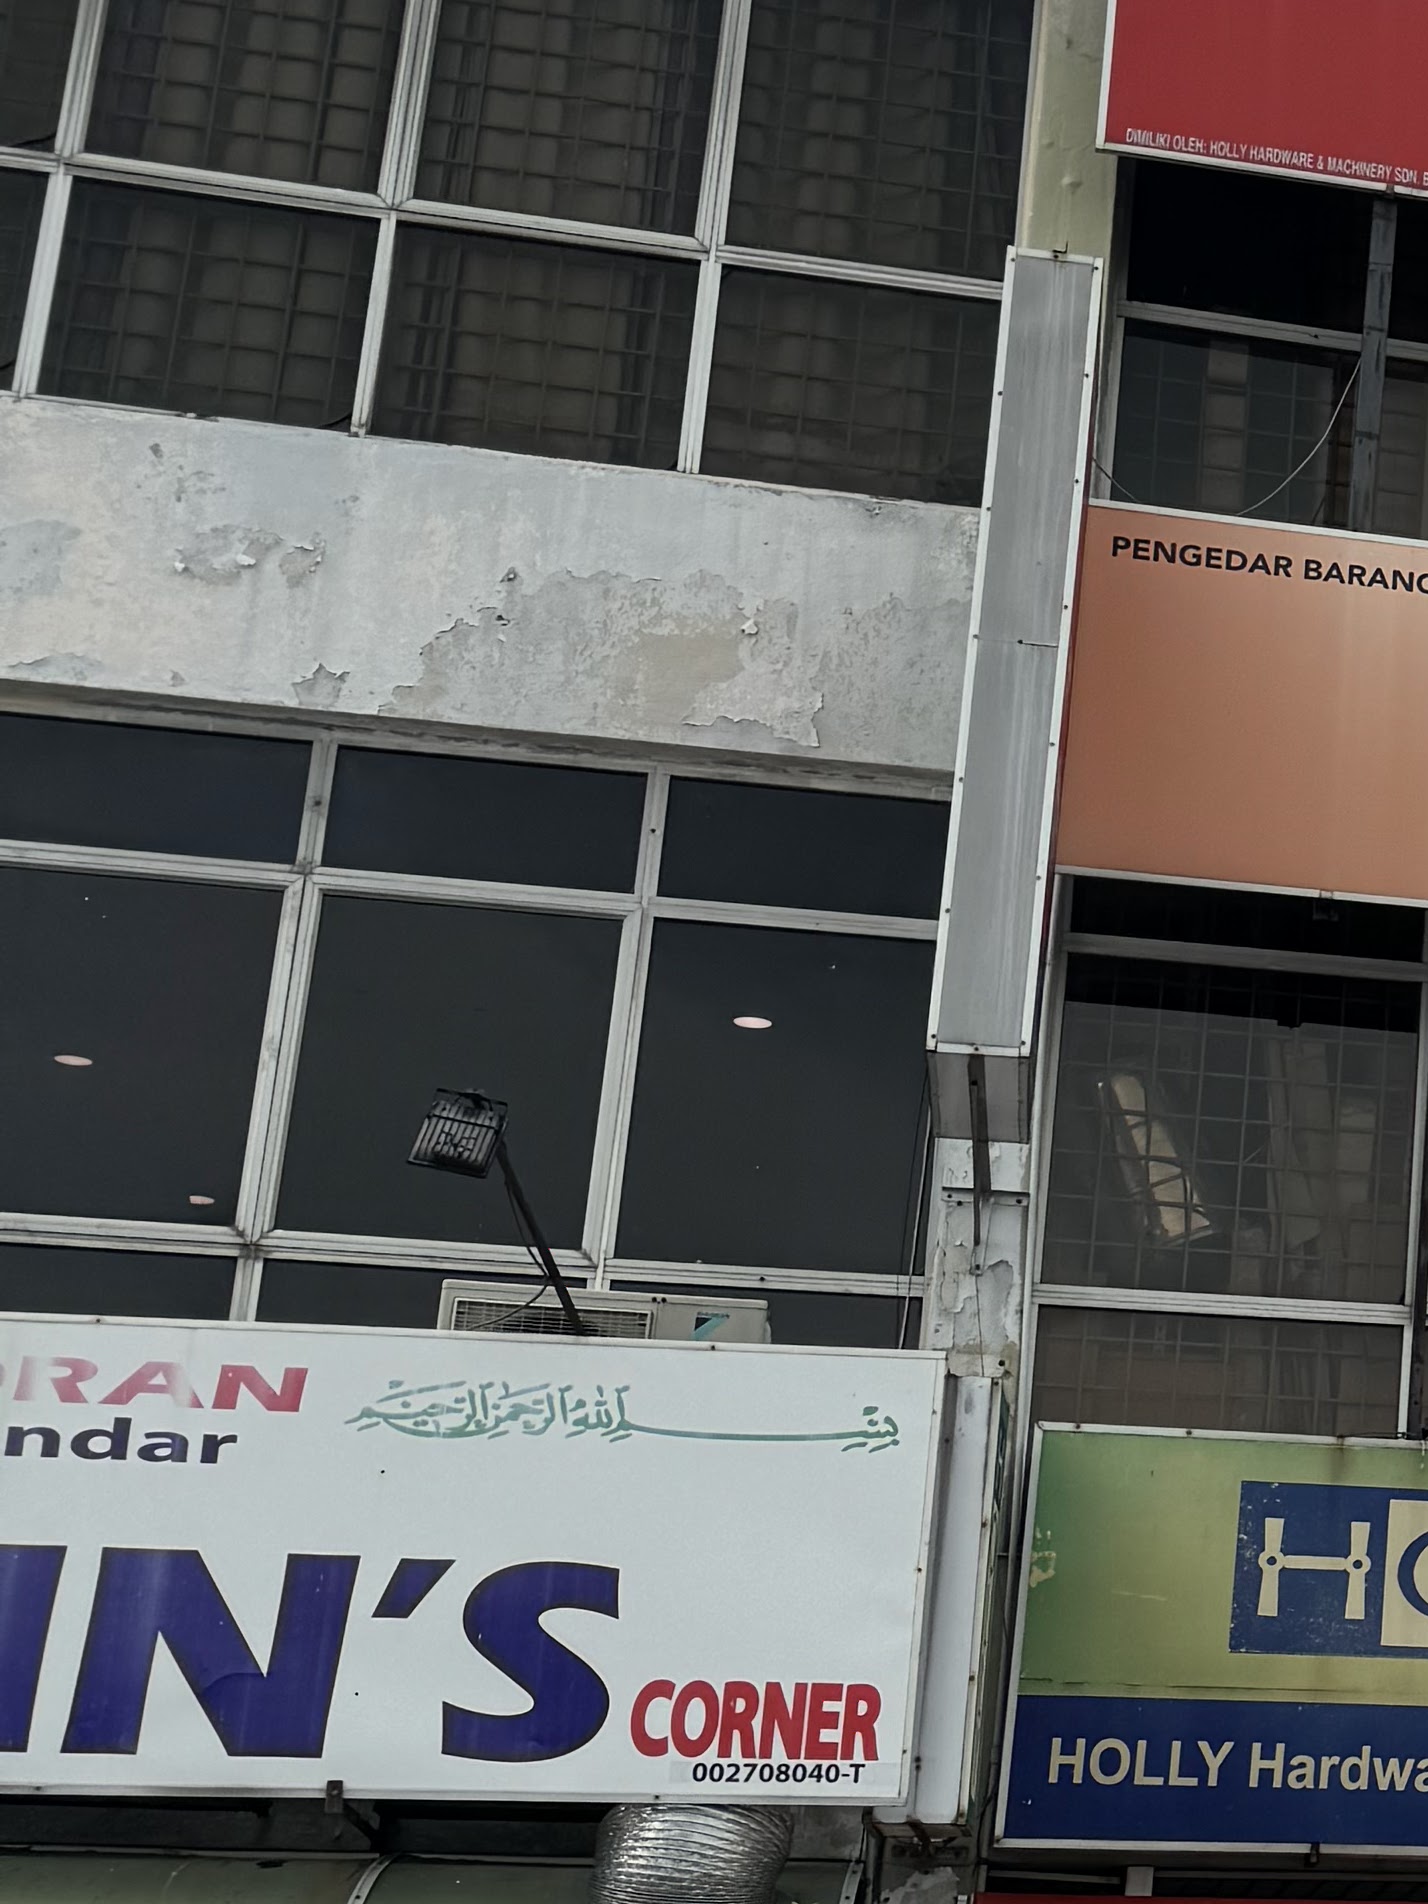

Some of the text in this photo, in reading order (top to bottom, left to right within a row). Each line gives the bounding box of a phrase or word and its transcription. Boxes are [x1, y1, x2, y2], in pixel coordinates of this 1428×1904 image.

[1126, 127, 1171, 149] DIMILIKI
[1172, 134, 1208, 154] OLEH:
[1209, 140, 1248, 161] HOLLY
[1249, 145, 1315, 169] HARDWARE
[1316, 155, 1325, 170] &
[1327, 156, 1393, 182] MACHINERY
[1394, 167, 1420, 184] SDN.
[1111, 534, 1294, 580] PENGEDAR
[0, 1355, 308, 1413] RAN
[630, 1679, 881, 1760] CORNER
[692, 1762, 866, 1784] 002708040-T
[1048, 1736, 1235, 1788] HOLLY
